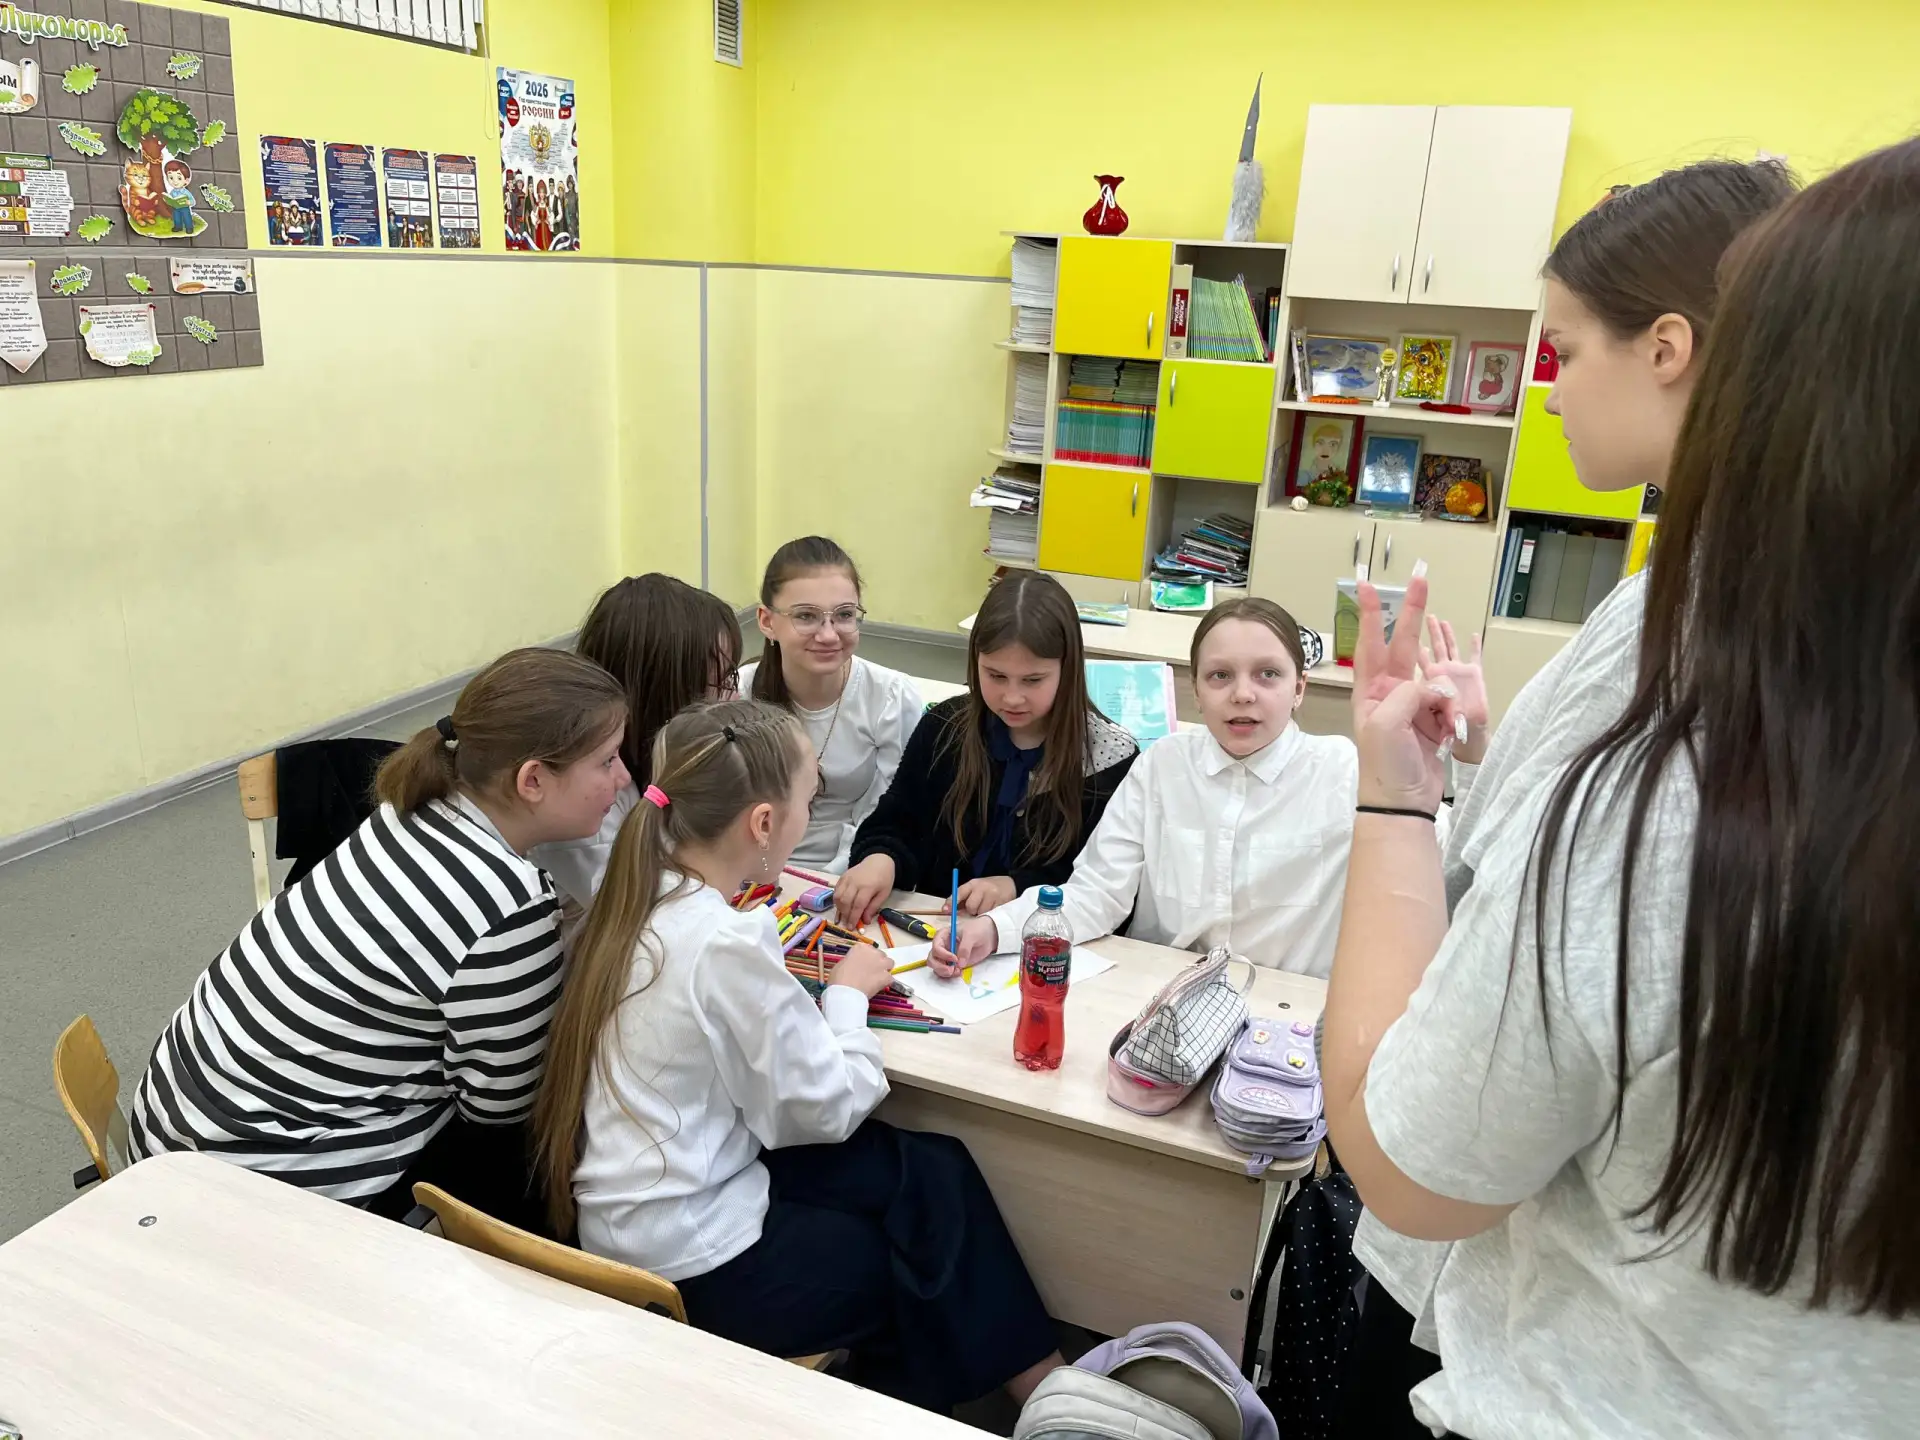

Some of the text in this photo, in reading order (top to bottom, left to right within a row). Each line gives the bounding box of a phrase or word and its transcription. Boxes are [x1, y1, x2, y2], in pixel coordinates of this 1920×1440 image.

[525, 80, 549, 98] 2026
[522, 105, 555, 120] РОССИИ
[63, 126, 101, 150] Журналист
